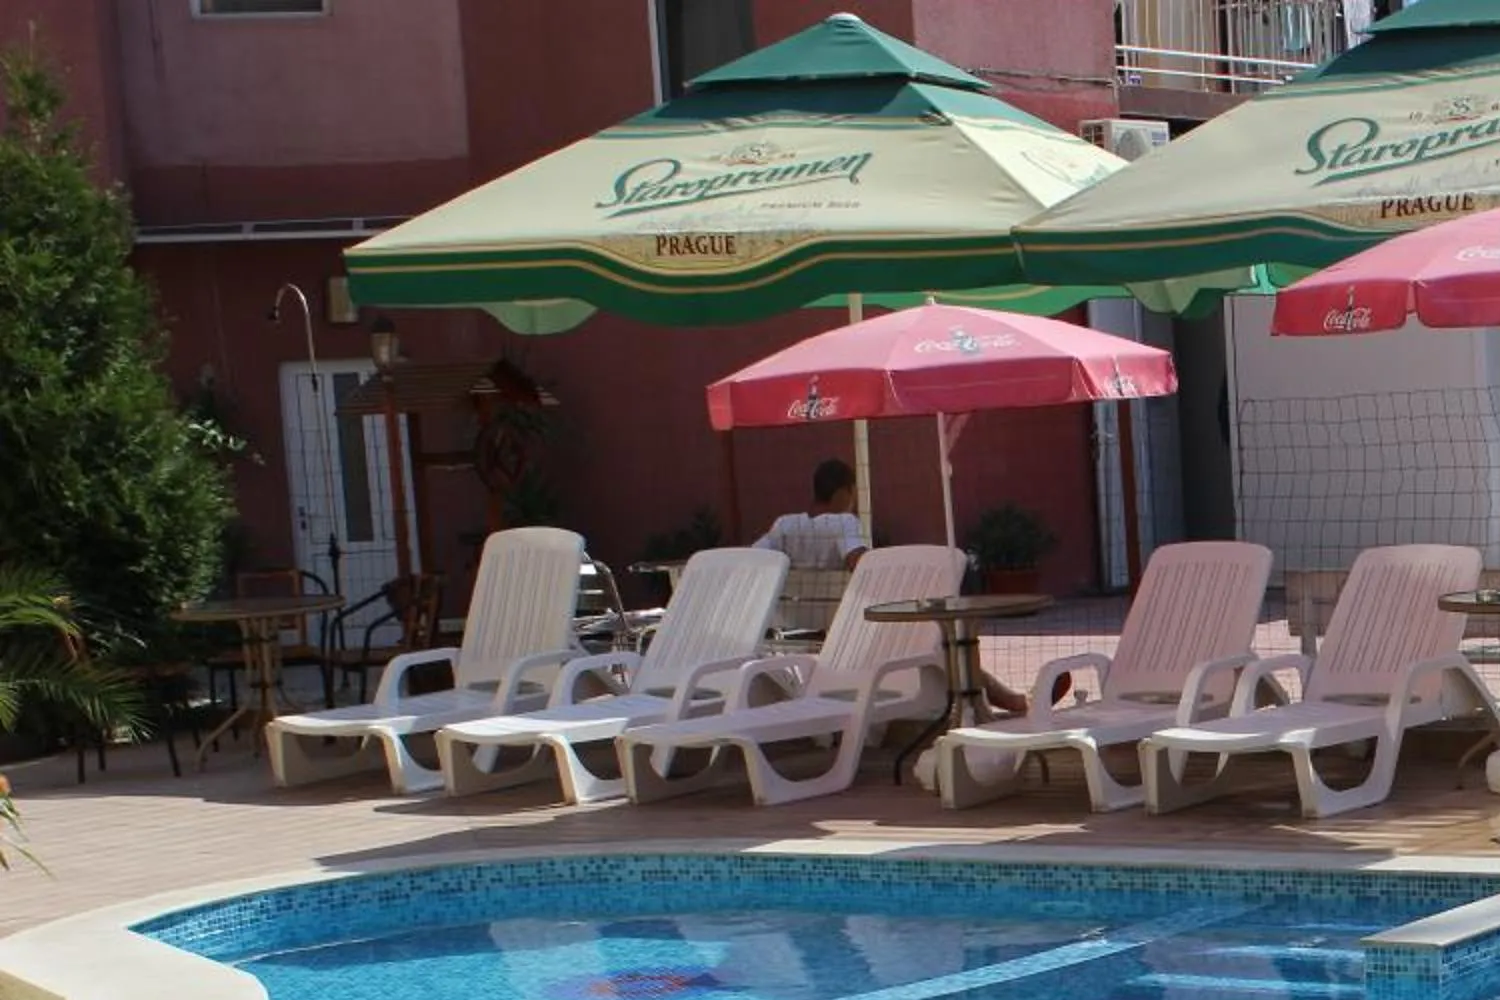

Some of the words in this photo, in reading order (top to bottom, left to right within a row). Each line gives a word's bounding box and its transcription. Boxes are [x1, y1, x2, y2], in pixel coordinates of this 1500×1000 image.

[594, 152, 873, 220] Staropramen
[1380, 192, 1475, 218] PRAGUE
[655, 234, 737, 256] PRAGUE
